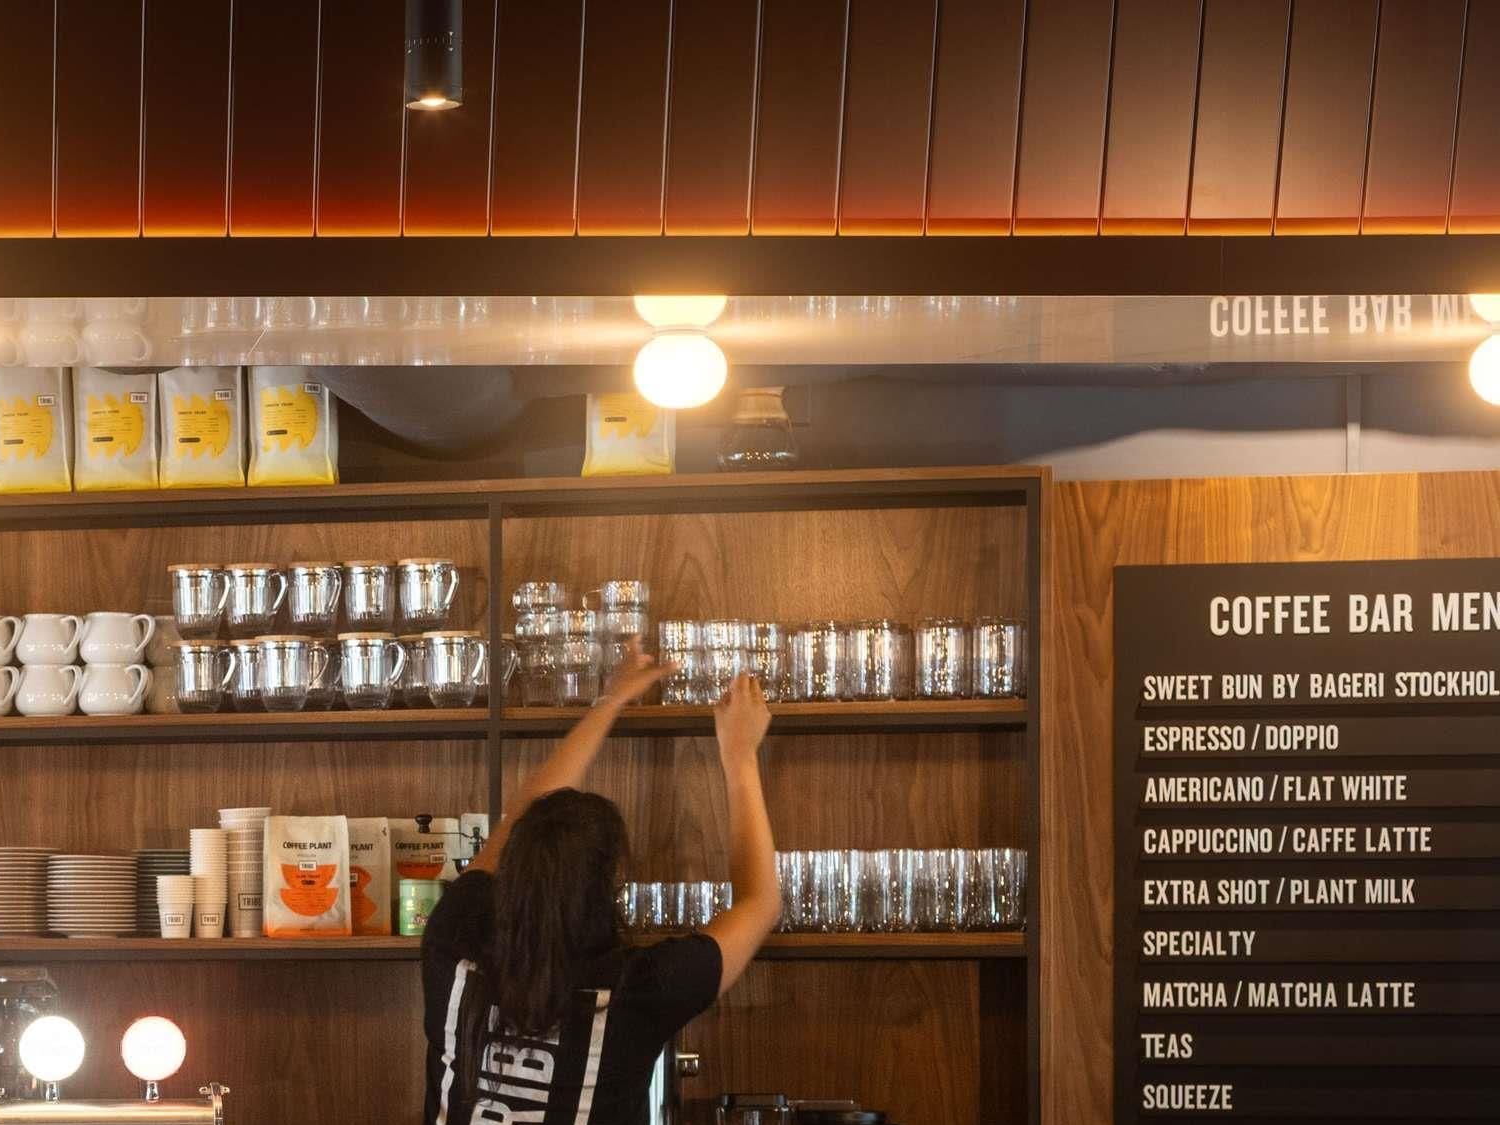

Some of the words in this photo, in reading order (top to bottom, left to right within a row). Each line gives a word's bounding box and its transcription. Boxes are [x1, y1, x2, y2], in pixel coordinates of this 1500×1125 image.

[1211, 595, 1330, 635] COFFEE
[1350, 594, 1413, 632] BAR
[1433, 592, 1500, 631] MEN
[1144, 675, 1212, 700] SWEET
[1222, 674, 1262, 699] BUN
[1273, 674, 1299, 698] BY
[1310, 673, 1384, 698] BAGERI
[1395, 671, 1500, 696] STOCKHOL
[1145, 726, 1245, 751] ESPRESSO
[1251, 724, 1260, 750] /
[1266, 725, 1338, 750] DOPPIO
[1145, 777, 1263, 802] AMERICANO
[1270, 775, 1278, 801] /
[1284, 776, 1334, 801] FLAT
[1342, 776, 1406, 800] WHITE
[309, 841, 332, 849] PLANT
[350, 843, 374, 851] PLANT
[1144, 828, 1272, 853] CAPPUCCINO
[1279, 826, 1287, 852] /
[1293, 828, 1356, 852] CAFFE
[1366, 827, 1431, 852] LATTE
[1144, 880, 1209, 904] EXTRA
[1218, 880, 1270, 904] SHOT
[1276, 878, 1285, 904] /
[1291, 879, 1357, 904] PLANT
[1365, 879, 1414, 903] MILK
[1144, 931, 1255, 955] SPECIALTY
[1144, 983, 1227, 1007] MATCHA
[1234, 981, 1242, 1007] /
[1249, 983, 1337, 1007] MATCHA
[1348, 983, 1414, 1007] LATTE
[1141, 1034, 1192, 1058] TEAS
[1143, 1085, 1232, 1109] SQUEEZE
